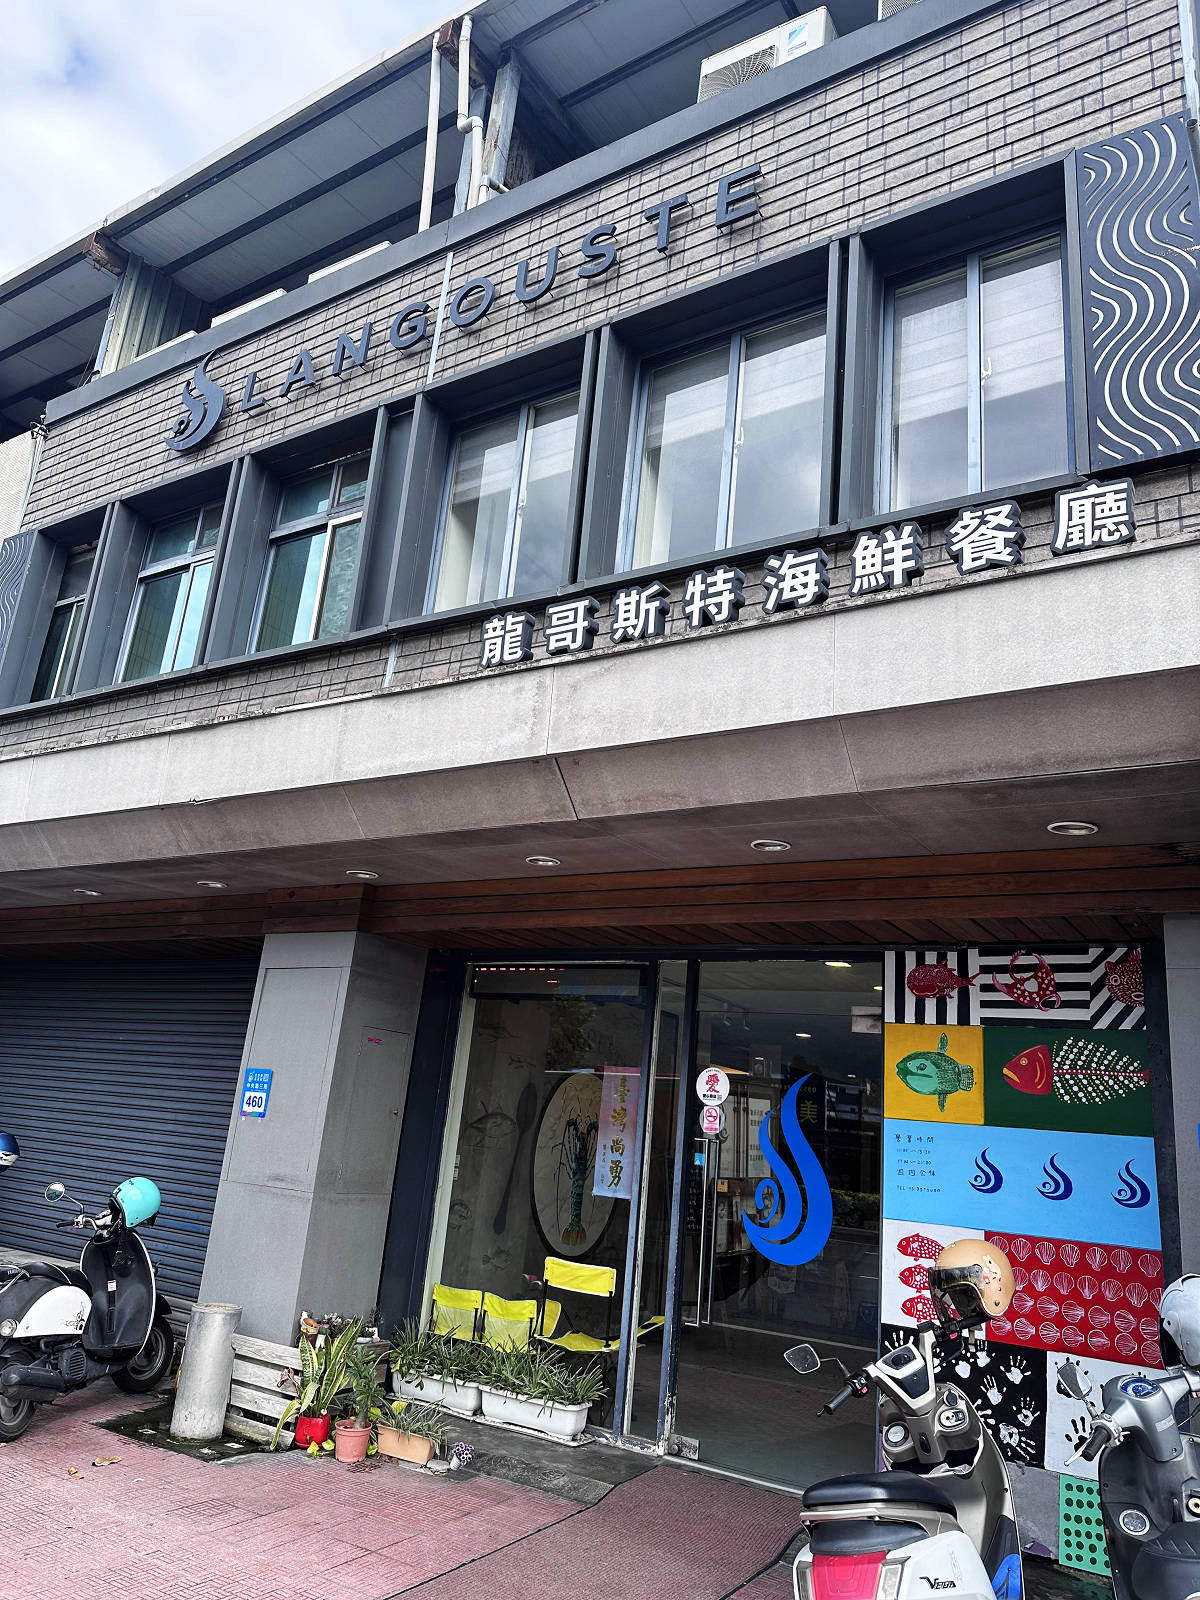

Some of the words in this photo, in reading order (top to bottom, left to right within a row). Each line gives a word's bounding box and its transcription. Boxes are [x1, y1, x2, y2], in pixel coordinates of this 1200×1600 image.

[240, 164, 762, 412] LANGOUSTE
[481, 479, 1135, 667] 龍哥斯特海鮮餐廳
[245, 1095, 262, 1107] 460
